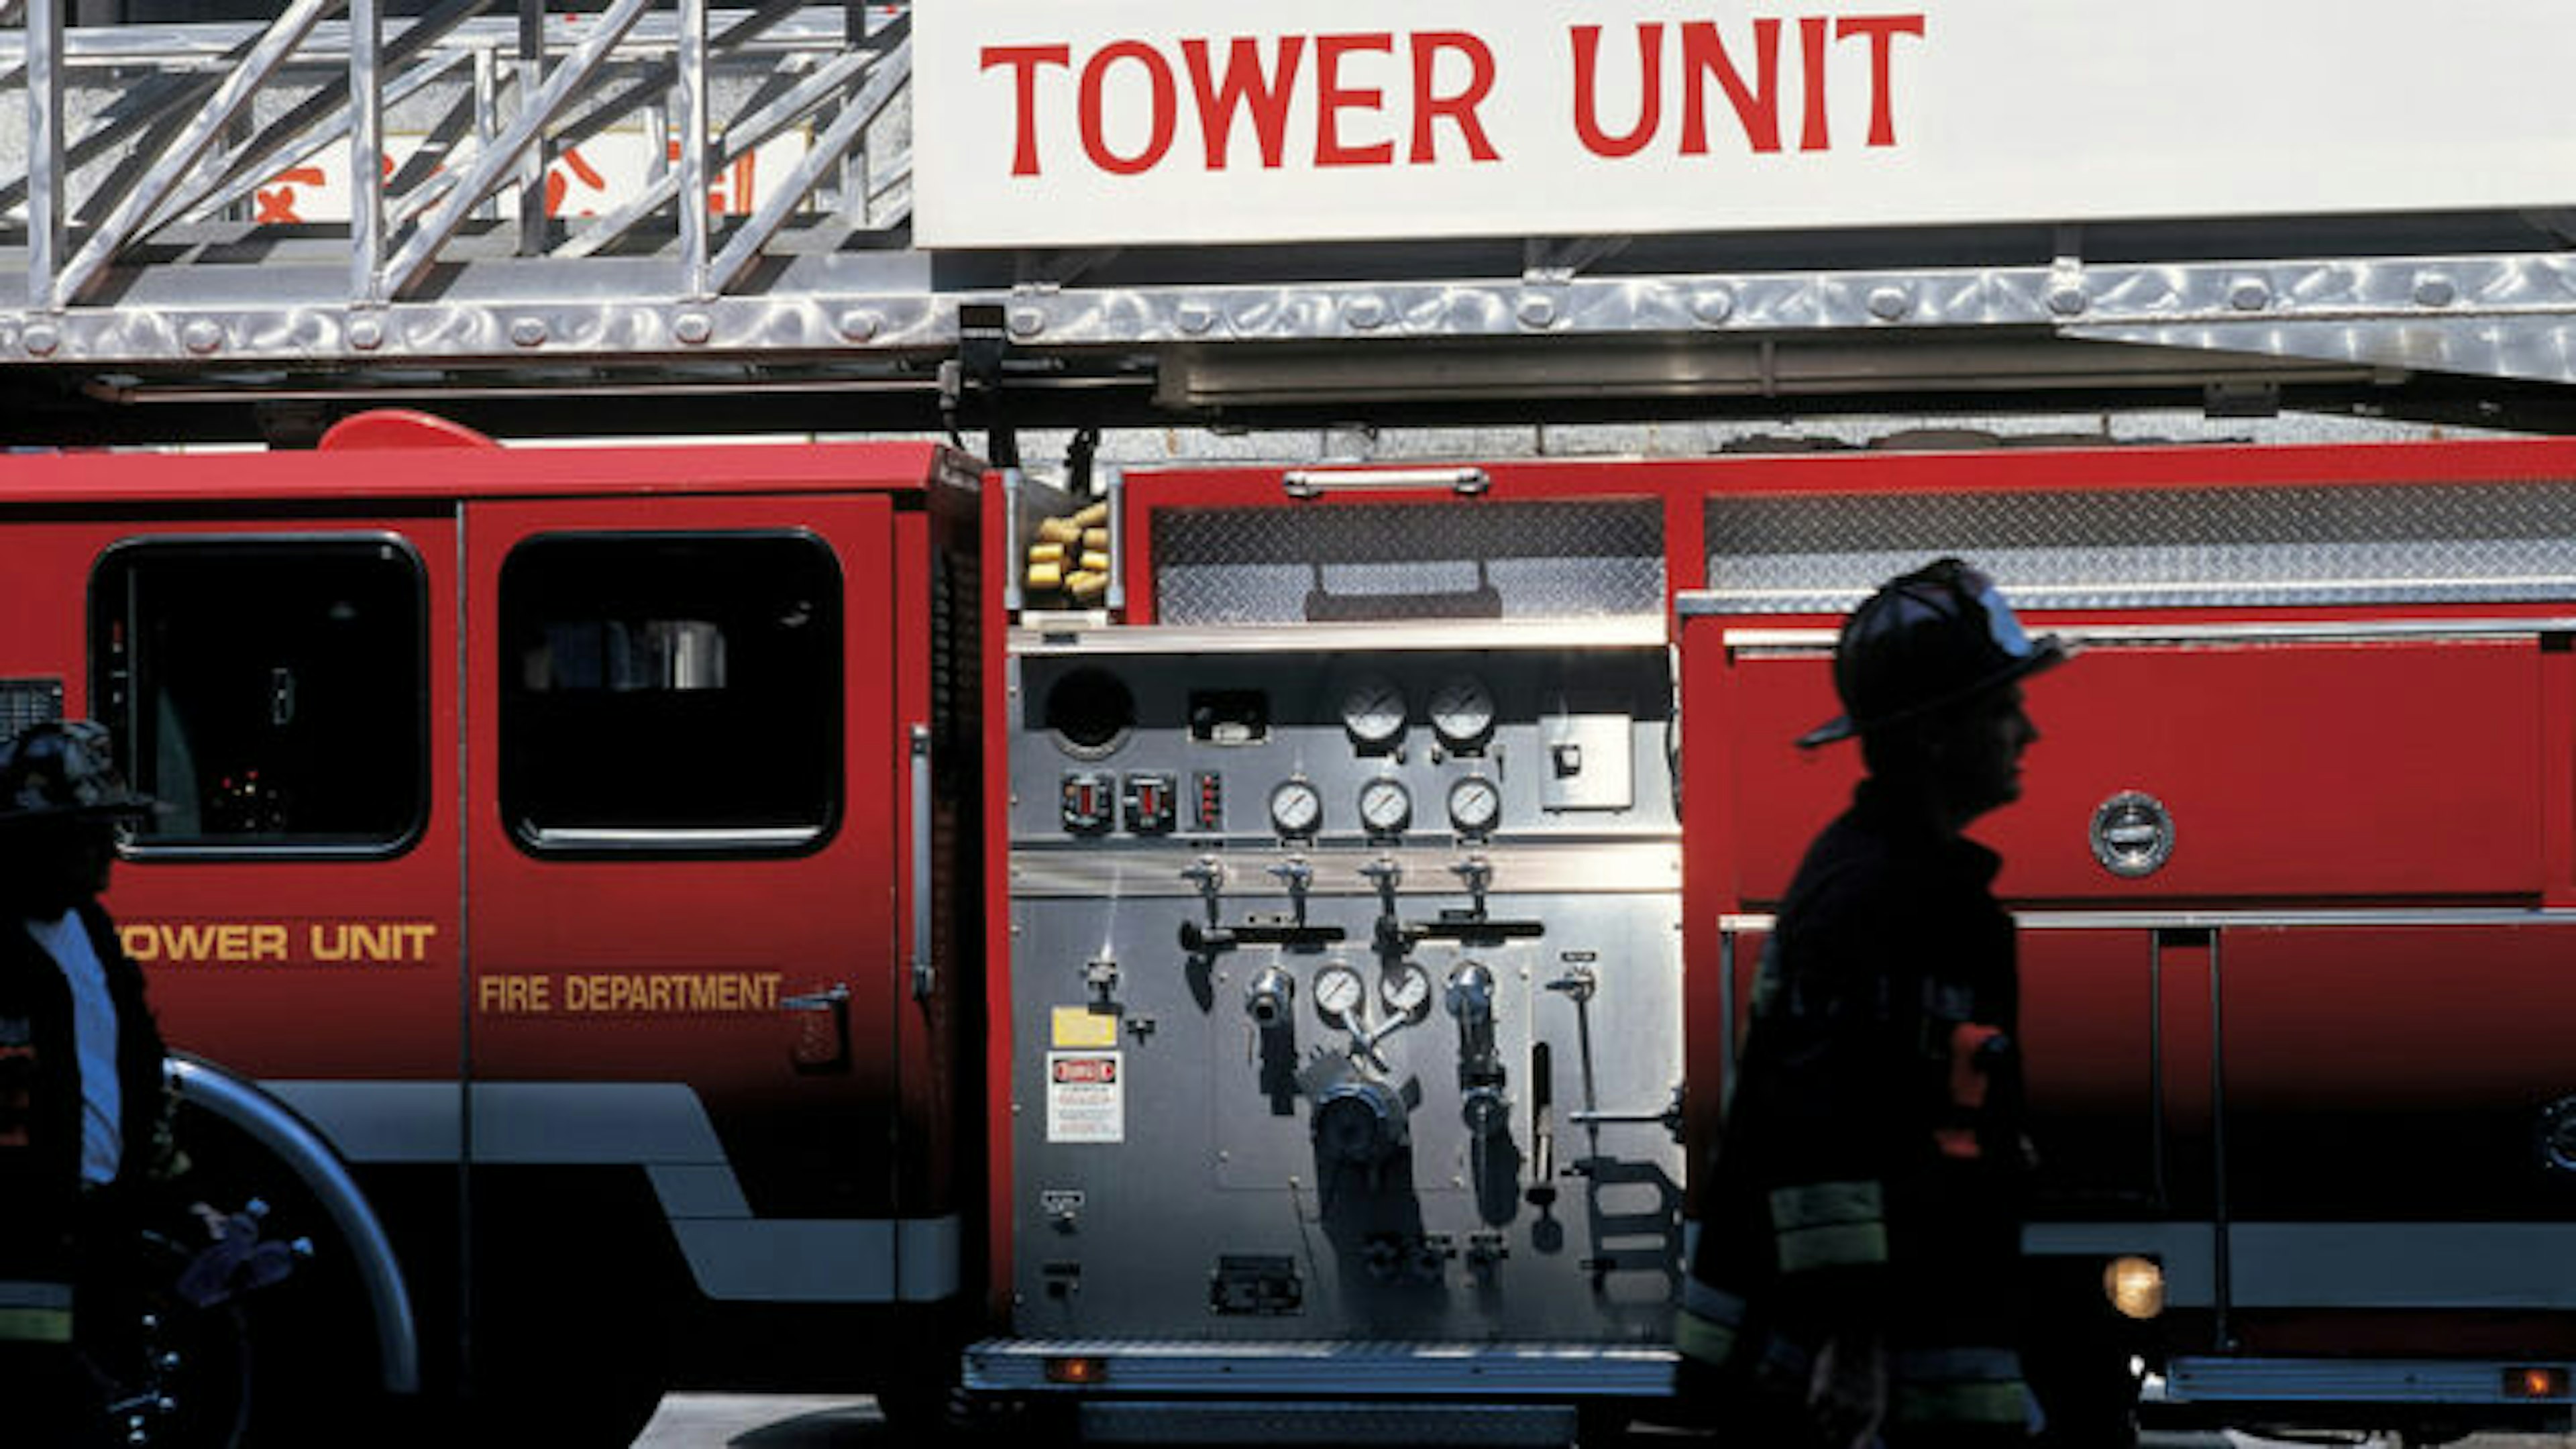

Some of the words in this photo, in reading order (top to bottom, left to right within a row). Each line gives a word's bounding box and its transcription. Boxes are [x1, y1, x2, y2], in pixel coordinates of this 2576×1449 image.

[981, 32, 1499, 176] TOWER
[1570, 14, 1925, 158] UNIT
[115, 924, 288, 961] OWER
[310, 924, 437, 961] UNIT
[480, 975, 549, 1011] FIRE
[566, 973, 782, 1011] DEPARTMENT
